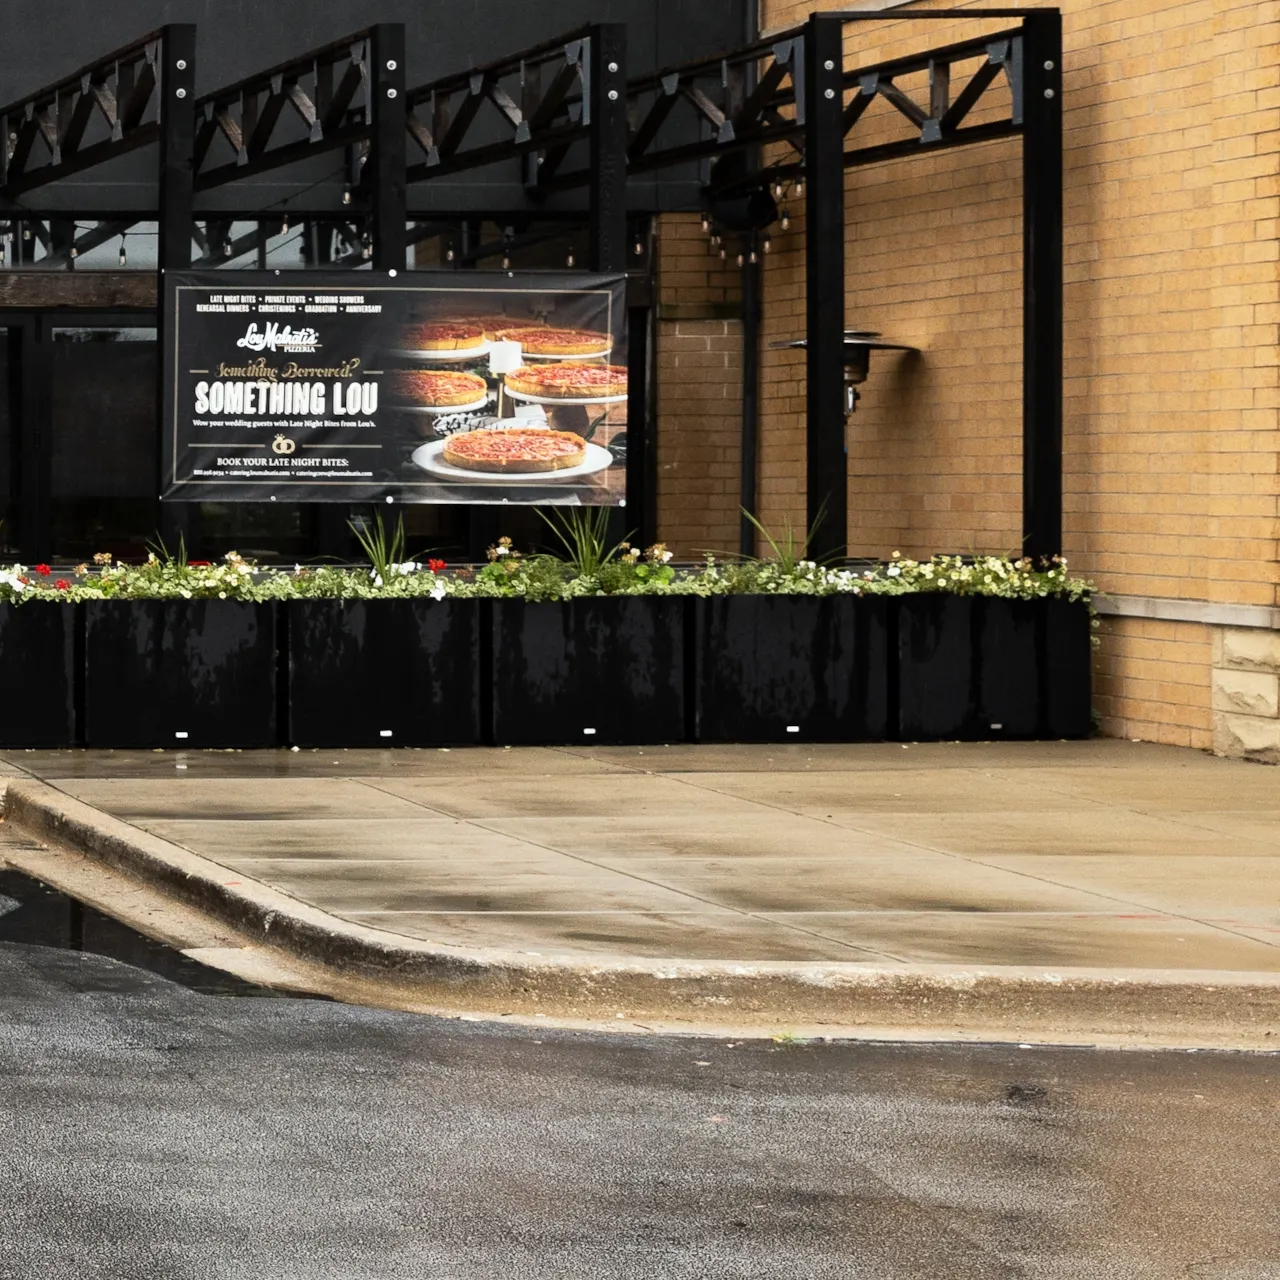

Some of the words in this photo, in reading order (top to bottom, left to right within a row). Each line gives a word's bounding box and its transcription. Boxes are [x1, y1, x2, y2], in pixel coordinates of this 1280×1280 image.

[286, 296, 306, 304] EVENTS
[237, 323, 265, 351] Lou
[195, 381, 326, 415] SOMETHING
[333, 382, 378, 415] LOU
[225, 420, 251, 428] wedding
[305, 420, 323, 428] Night
[217, 458, 241, 466] BOOK
[242, 458, 267, 466] YOUR
[268, 458, 289, 466] LATE
[291, 458, 320, 467] NIGHT
[322, 458, 349, 467] BITES:
